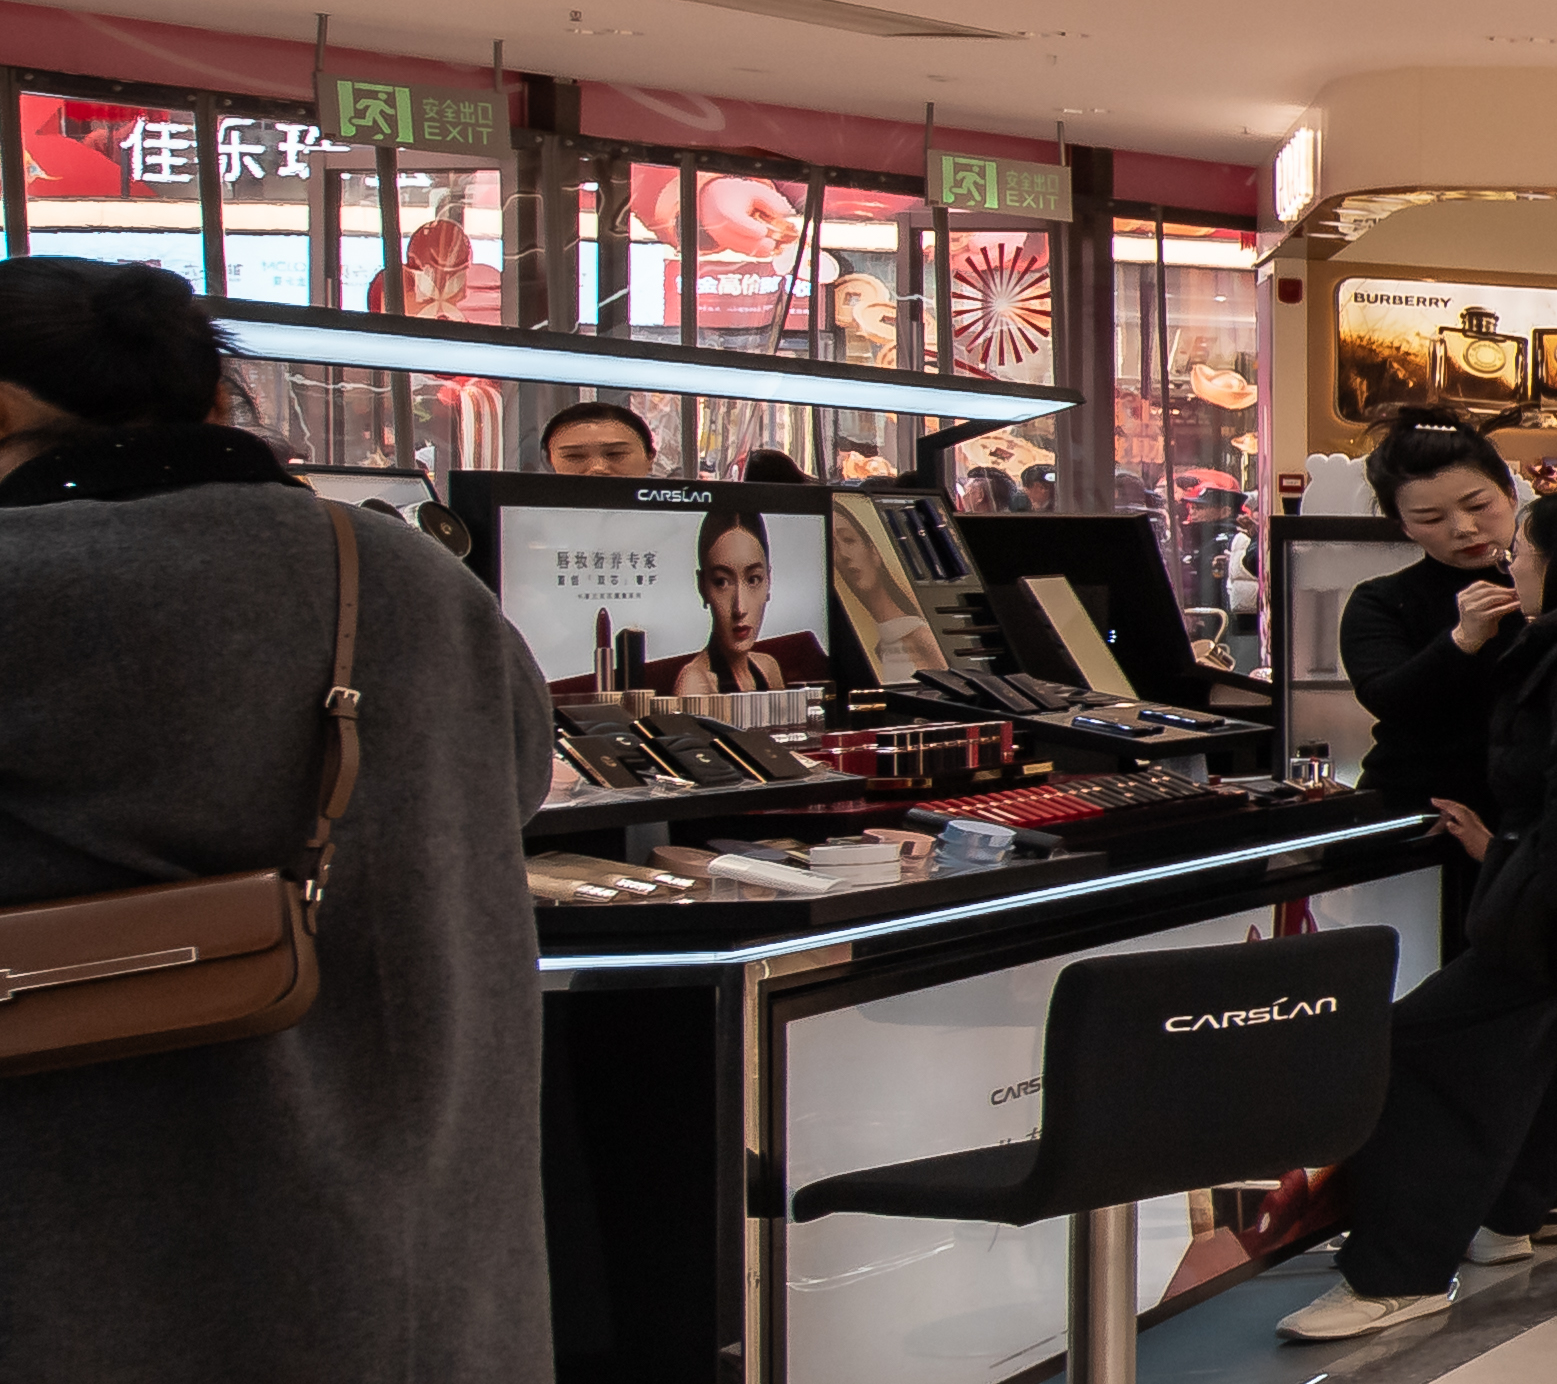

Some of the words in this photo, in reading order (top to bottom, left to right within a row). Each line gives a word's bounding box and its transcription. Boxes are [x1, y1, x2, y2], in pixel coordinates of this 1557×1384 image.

[424, 97, 493, 126] 安全出口
[425, 123, 493, 145] EXIT
[1005, 168, 1060, 194] 安全出口
[1005, 191, 1060, 211] EXIT
[1353, 292, 1452, 309] BURBERRY
[637, 487, 712, 503] CARSLAN
[1164, 996, 1337, 1032] CARSLAN
[991, 1077, 1041, 1106] CARS
